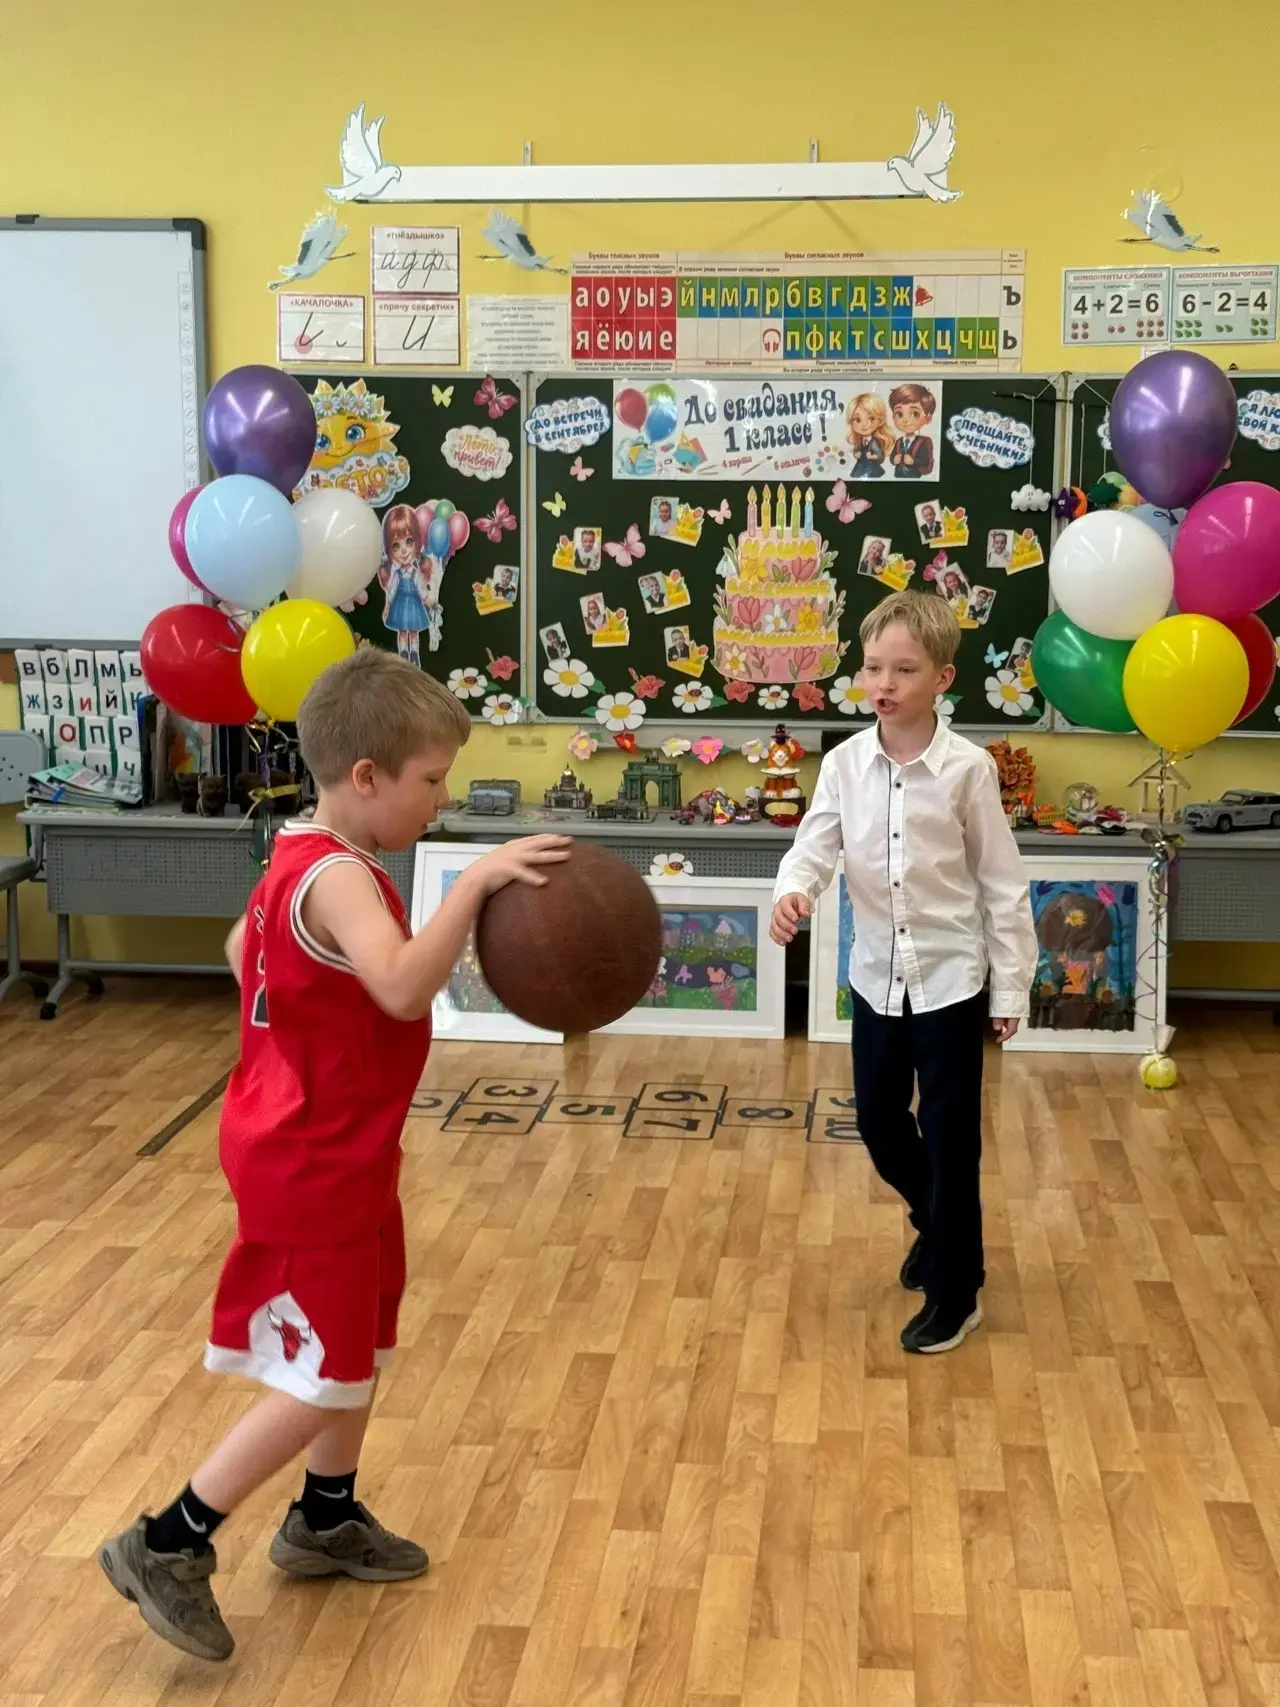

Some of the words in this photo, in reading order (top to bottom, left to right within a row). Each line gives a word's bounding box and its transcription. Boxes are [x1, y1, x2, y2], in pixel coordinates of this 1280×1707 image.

[290, 298, 354, 309] «КАЧАЛОЧКА»
[684, 395, 717, 427] До
[723, 382, 845, 422] свидания,
[534, 418, 551, 430] ДО
[553, 408, 603, 426] ВСТРЕЧИ
[534, 434, 542, 443] В
[545, 421, 605, 441] СЕНТЯБРЕ!
[724, 426, 740, 453] 1
[746, 422, 813, 451] класс
[961, 419, 1027, 448] ПРОЩАЙТЕ,
[956, 433, 1026, 461] УЧЕБНИКИ!
[463, 1111, 519, 1126] 4
[560, 1102, 616, 1116] 5
[737, 1106, 794, 1120] 8
[643, 1117, 702, 1132] 7
